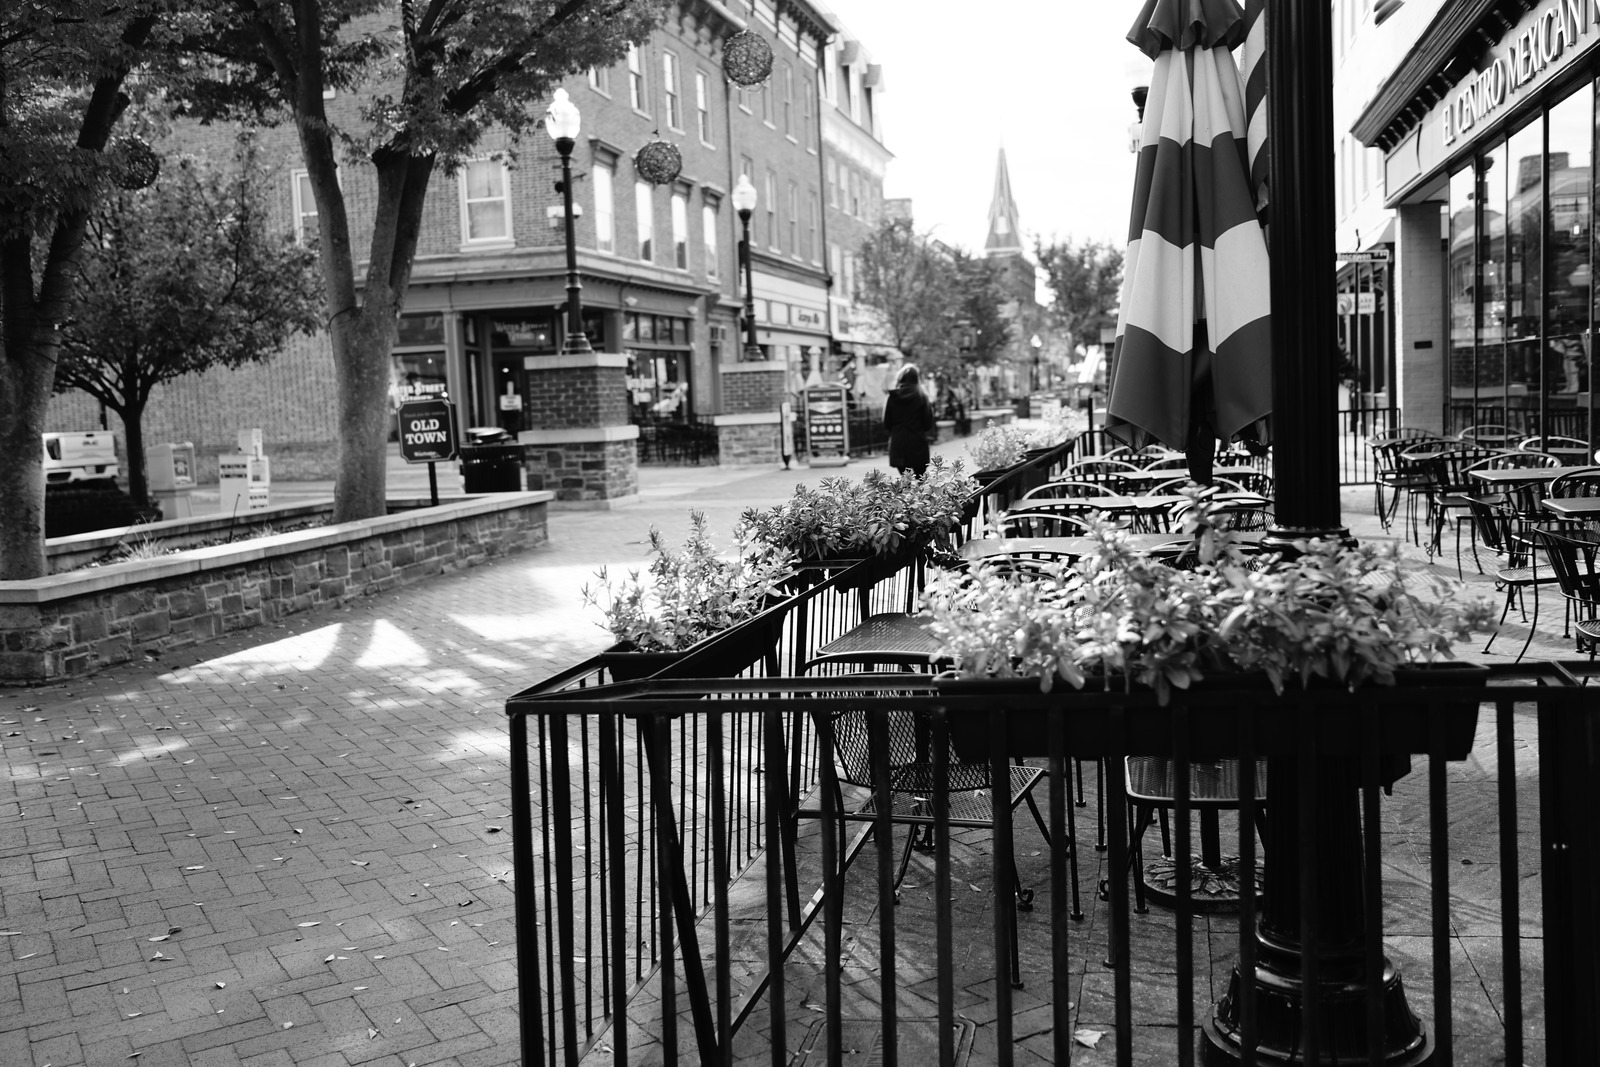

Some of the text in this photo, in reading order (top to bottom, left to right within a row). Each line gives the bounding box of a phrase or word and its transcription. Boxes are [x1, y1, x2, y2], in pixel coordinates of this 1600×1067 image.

[1442, 0, 1587, 146] EL CENTRO MEXICAN
[410, 418, 440, 432] OLD
[405, 430, 447, 445] TOWN
